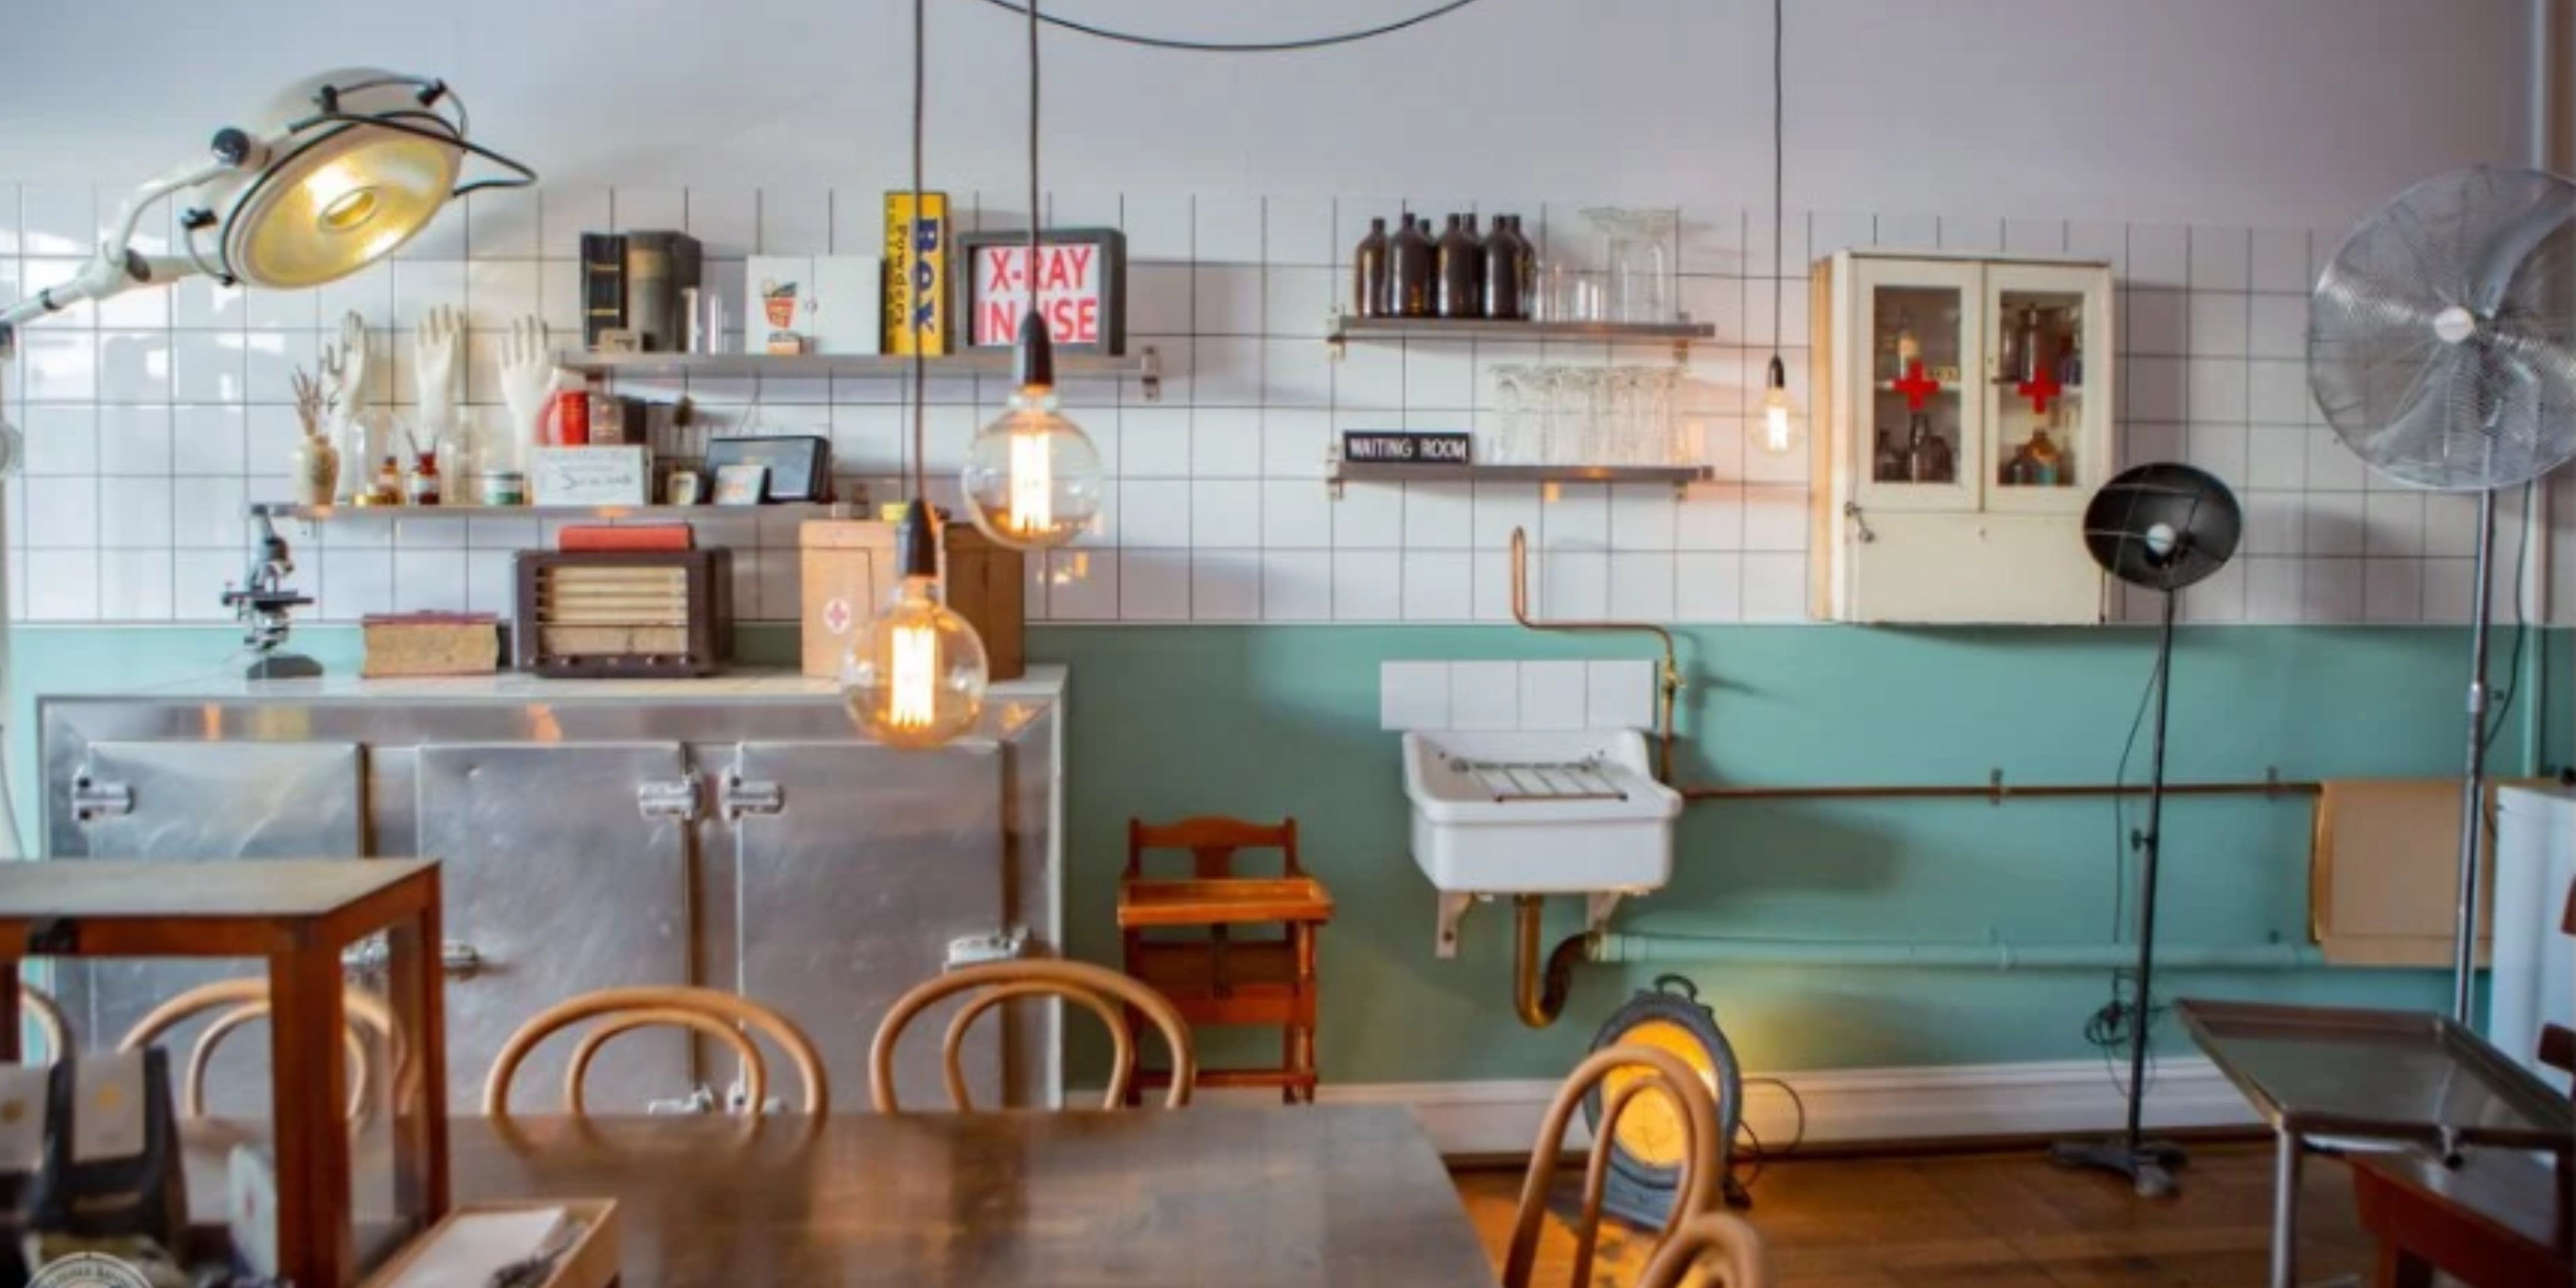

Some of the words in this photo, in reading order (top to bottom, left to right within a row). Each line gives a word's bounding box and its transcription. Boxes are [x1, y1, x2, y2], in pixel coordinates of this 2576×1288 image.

[990, 246, 1092, 292] X-RAY
[976, 300, 1015, 344] IN
[1350, 438, 1413, 458] WAITING
[1420, 438, 1467, 459] ROOM
